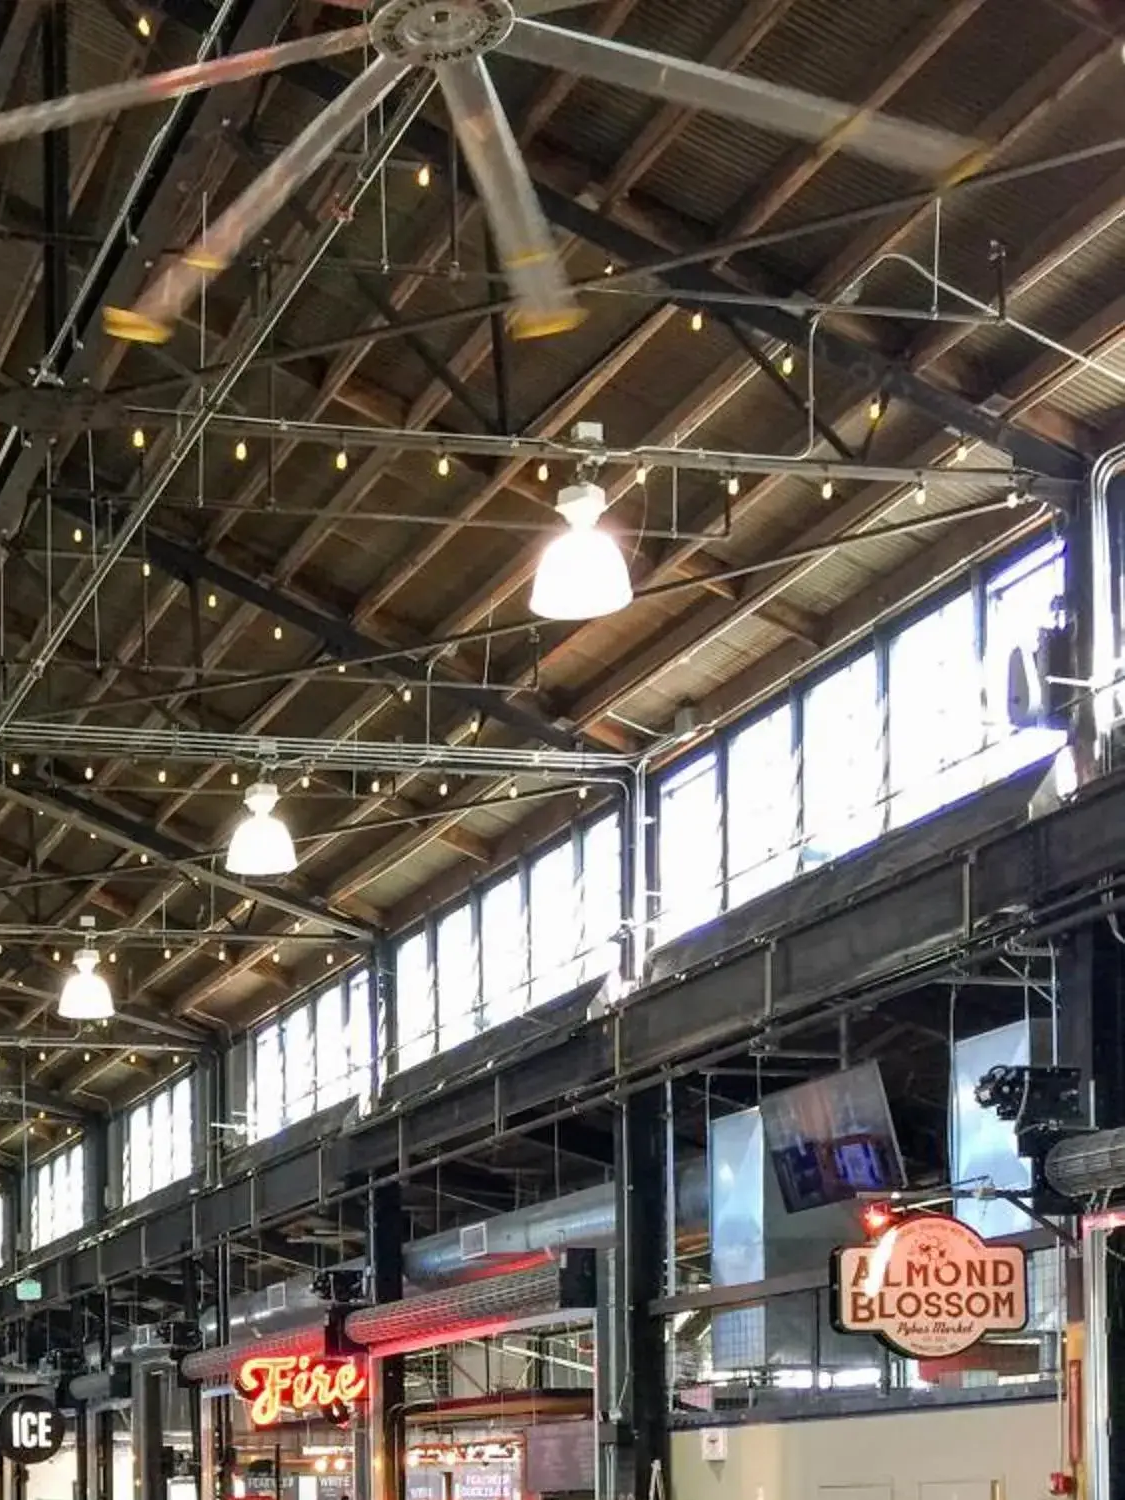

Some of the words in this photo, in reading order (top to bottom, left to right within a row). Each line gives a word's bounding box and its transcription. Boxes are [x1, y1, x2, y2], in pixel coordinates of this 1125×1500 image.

[851, 1256, 1015, 1287] ALMOND
[850, 1291, 1015, 1323] BLOSSOM
[932, 1320, 974, 1334] Market
[240, 1356, 366, 1425] Fire
[12, 1411, 52, 1448] ICE
